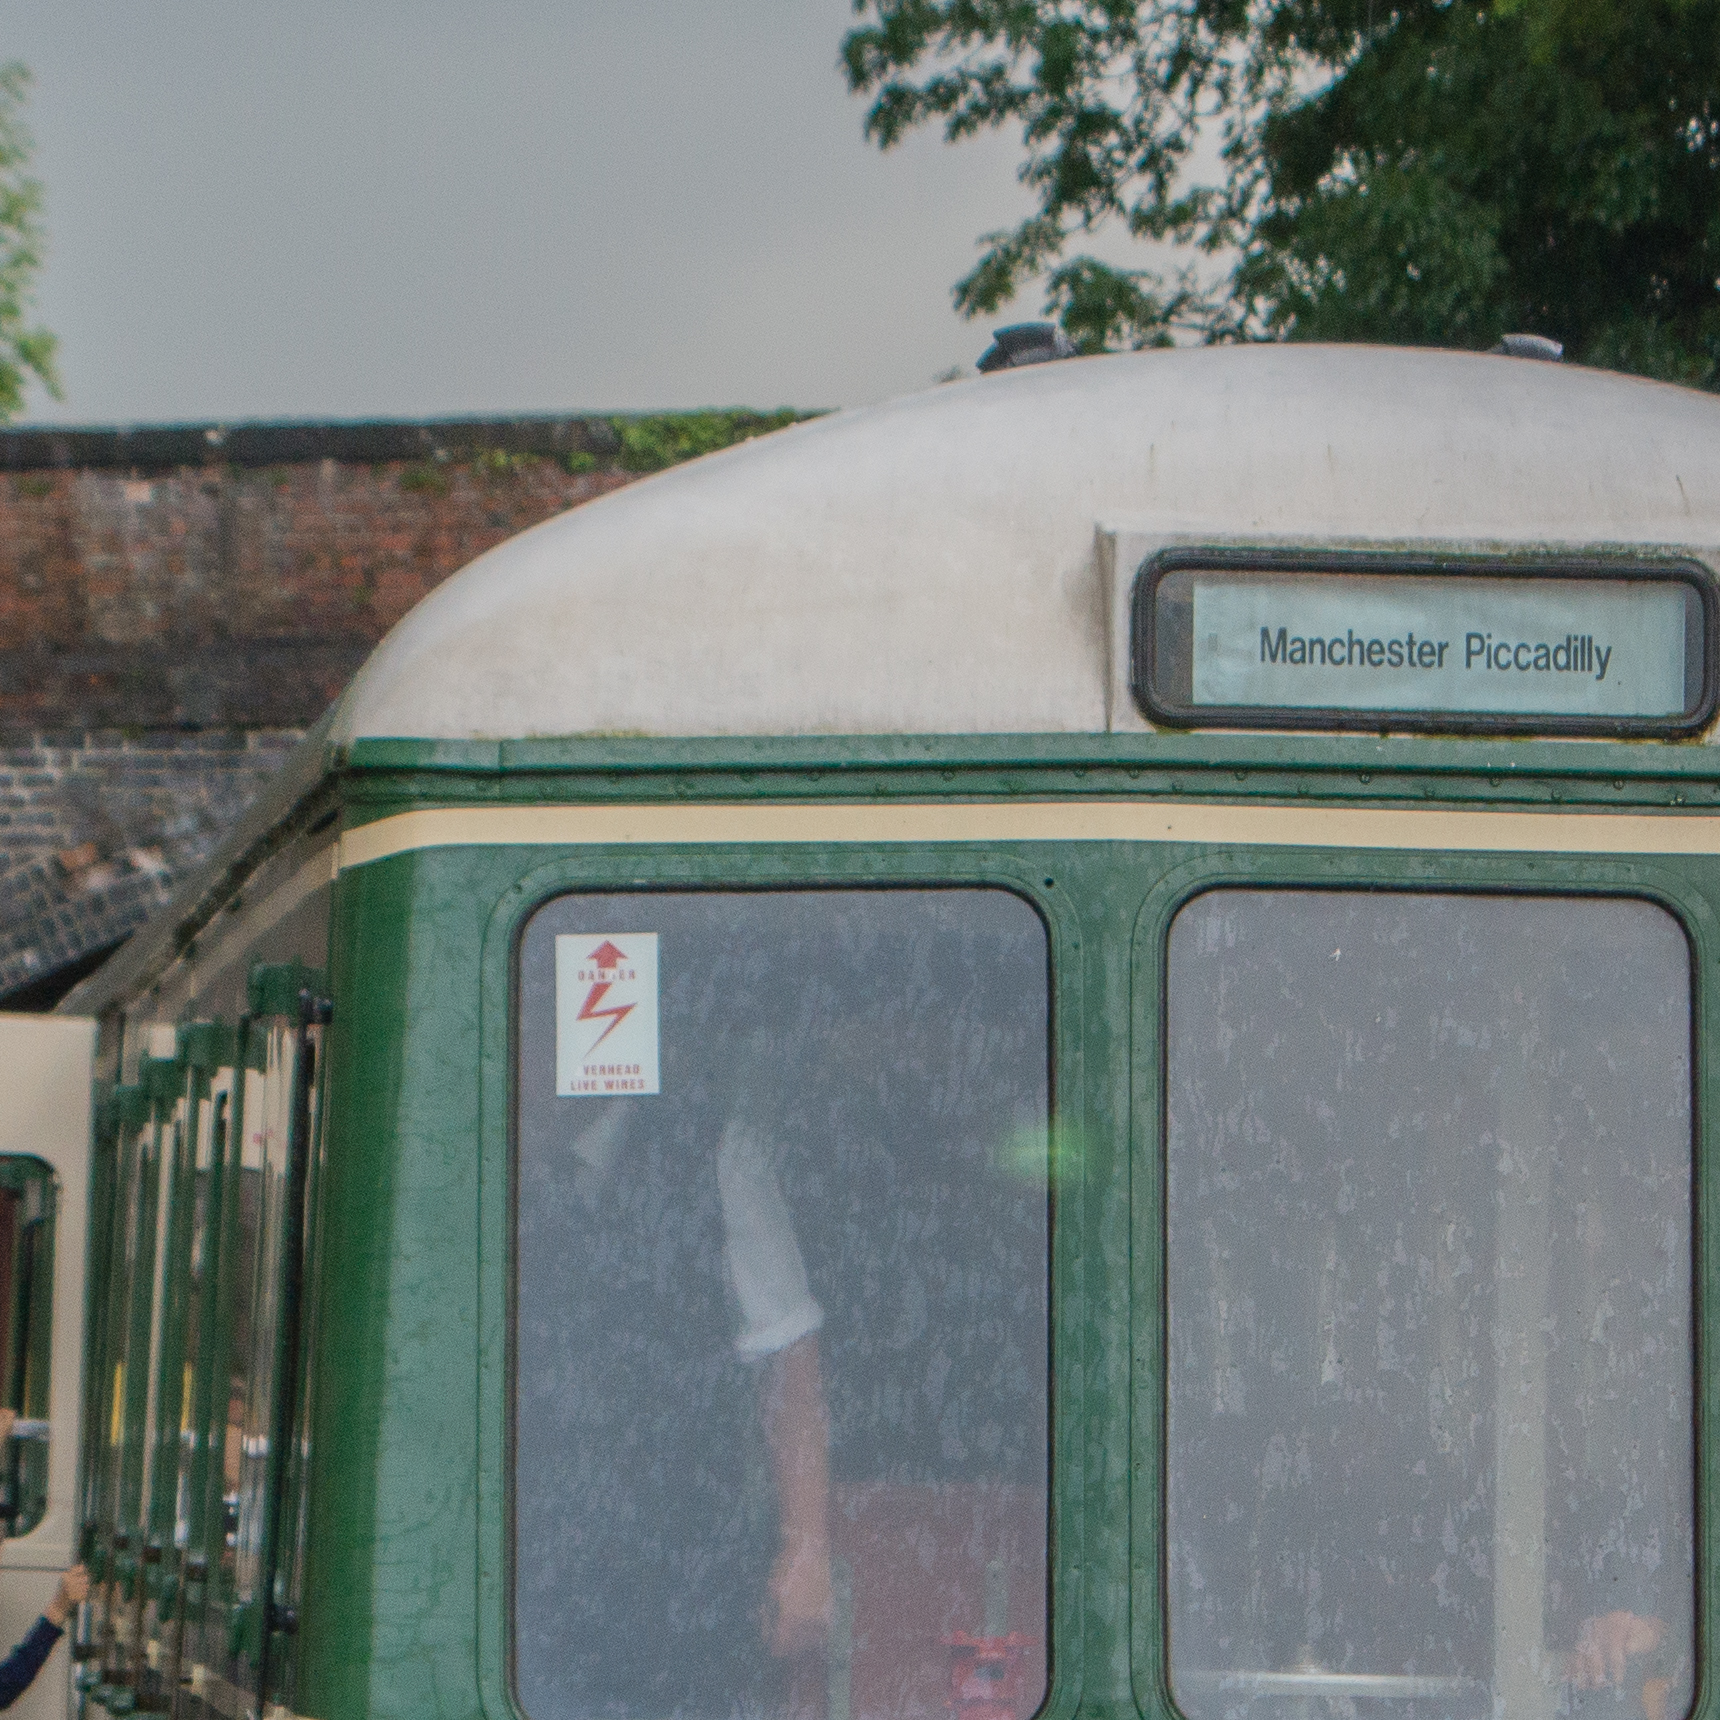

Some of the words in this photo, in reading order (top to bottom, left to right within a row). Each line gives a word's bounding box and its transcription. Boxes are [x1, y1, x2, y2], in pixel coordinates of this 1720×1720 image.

[1259, 625, 1449, 669] Manchester
[1464, 632, 1612, 680] Piccadilly
[577, 969, 636, 981] DANER
[570, 1079, 597, 1091] LIVE
[604, 1079, 645, 1091] WIRES
